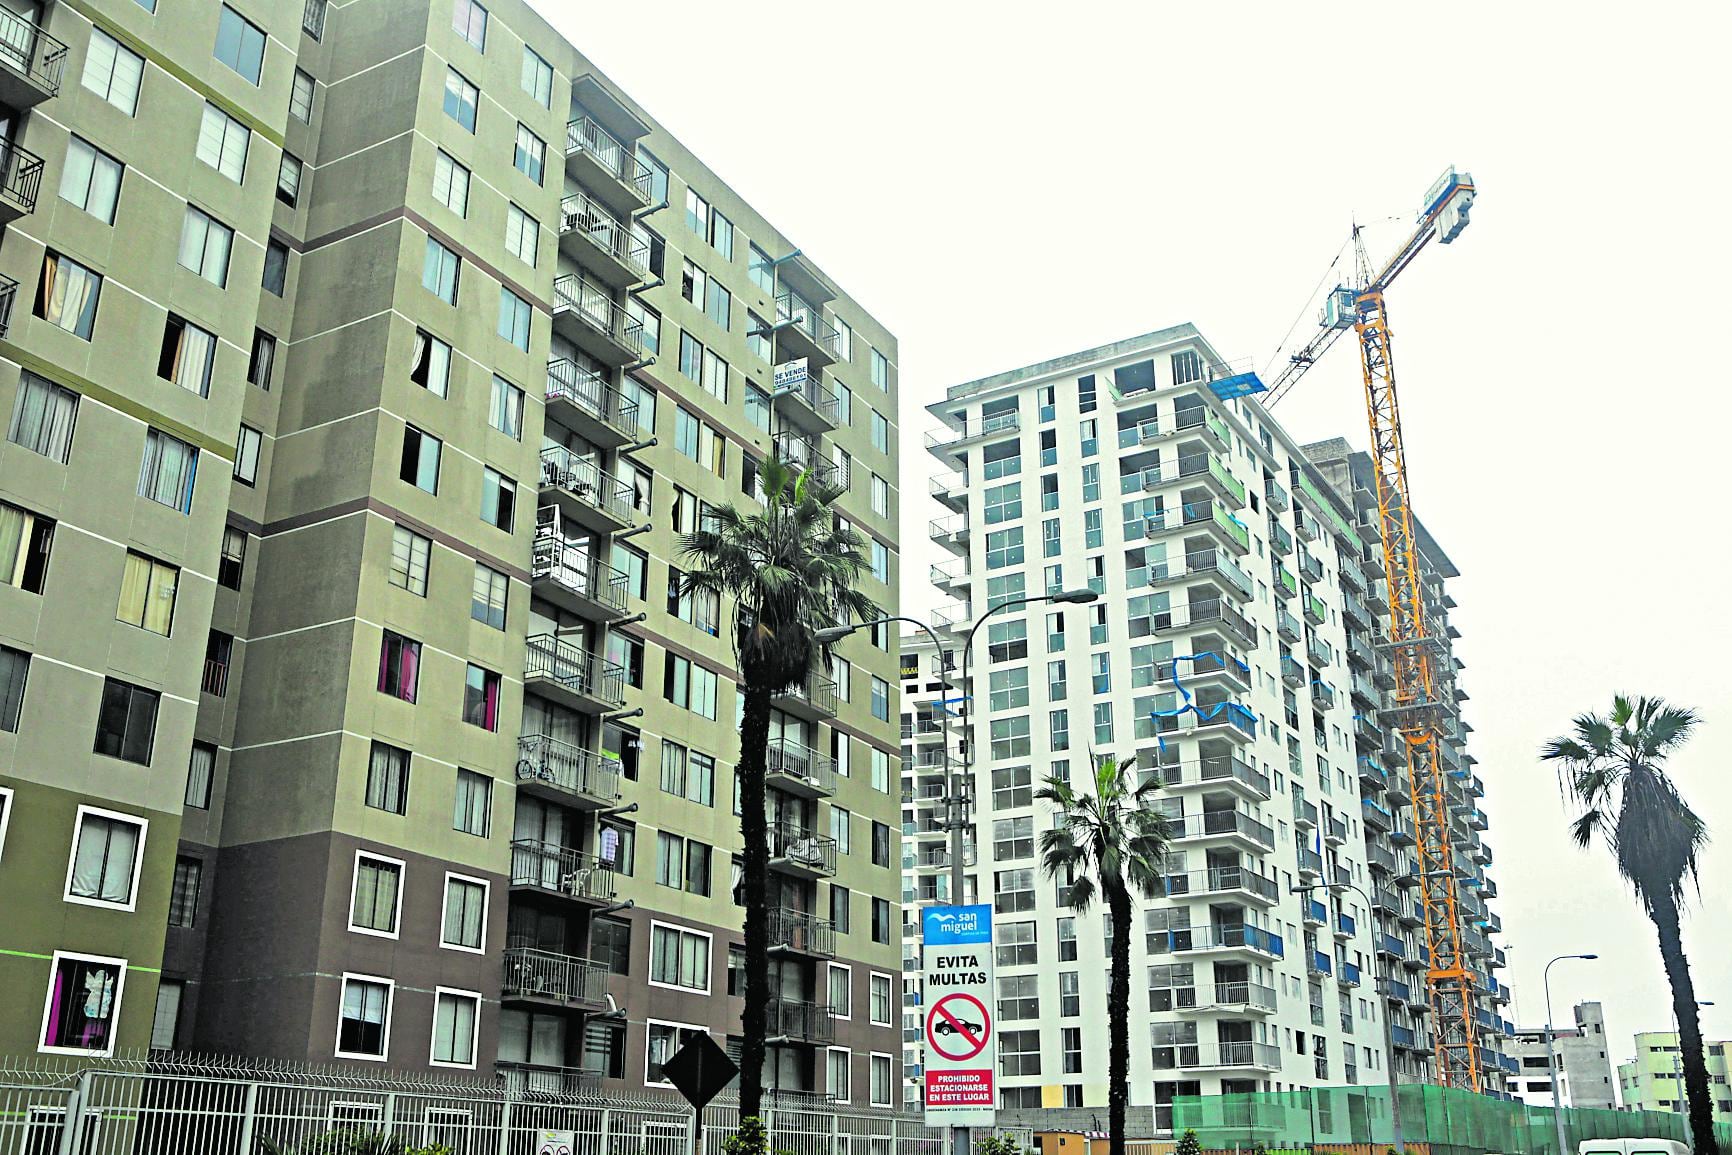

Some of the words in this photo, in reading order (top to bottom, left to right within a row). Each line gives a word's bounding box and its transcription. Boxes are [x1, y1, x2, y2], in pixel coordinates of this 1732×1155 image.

[785, 367, 806, 377] VENDE
[959, 913, 977, 922] san
[941, 921, 977, 934] miguel
[937, 955, 979, 968] EVITA
[930, 972, 987, 986] MULTAS
[930, 1084, 988, 1092] ESTACIONARSE
